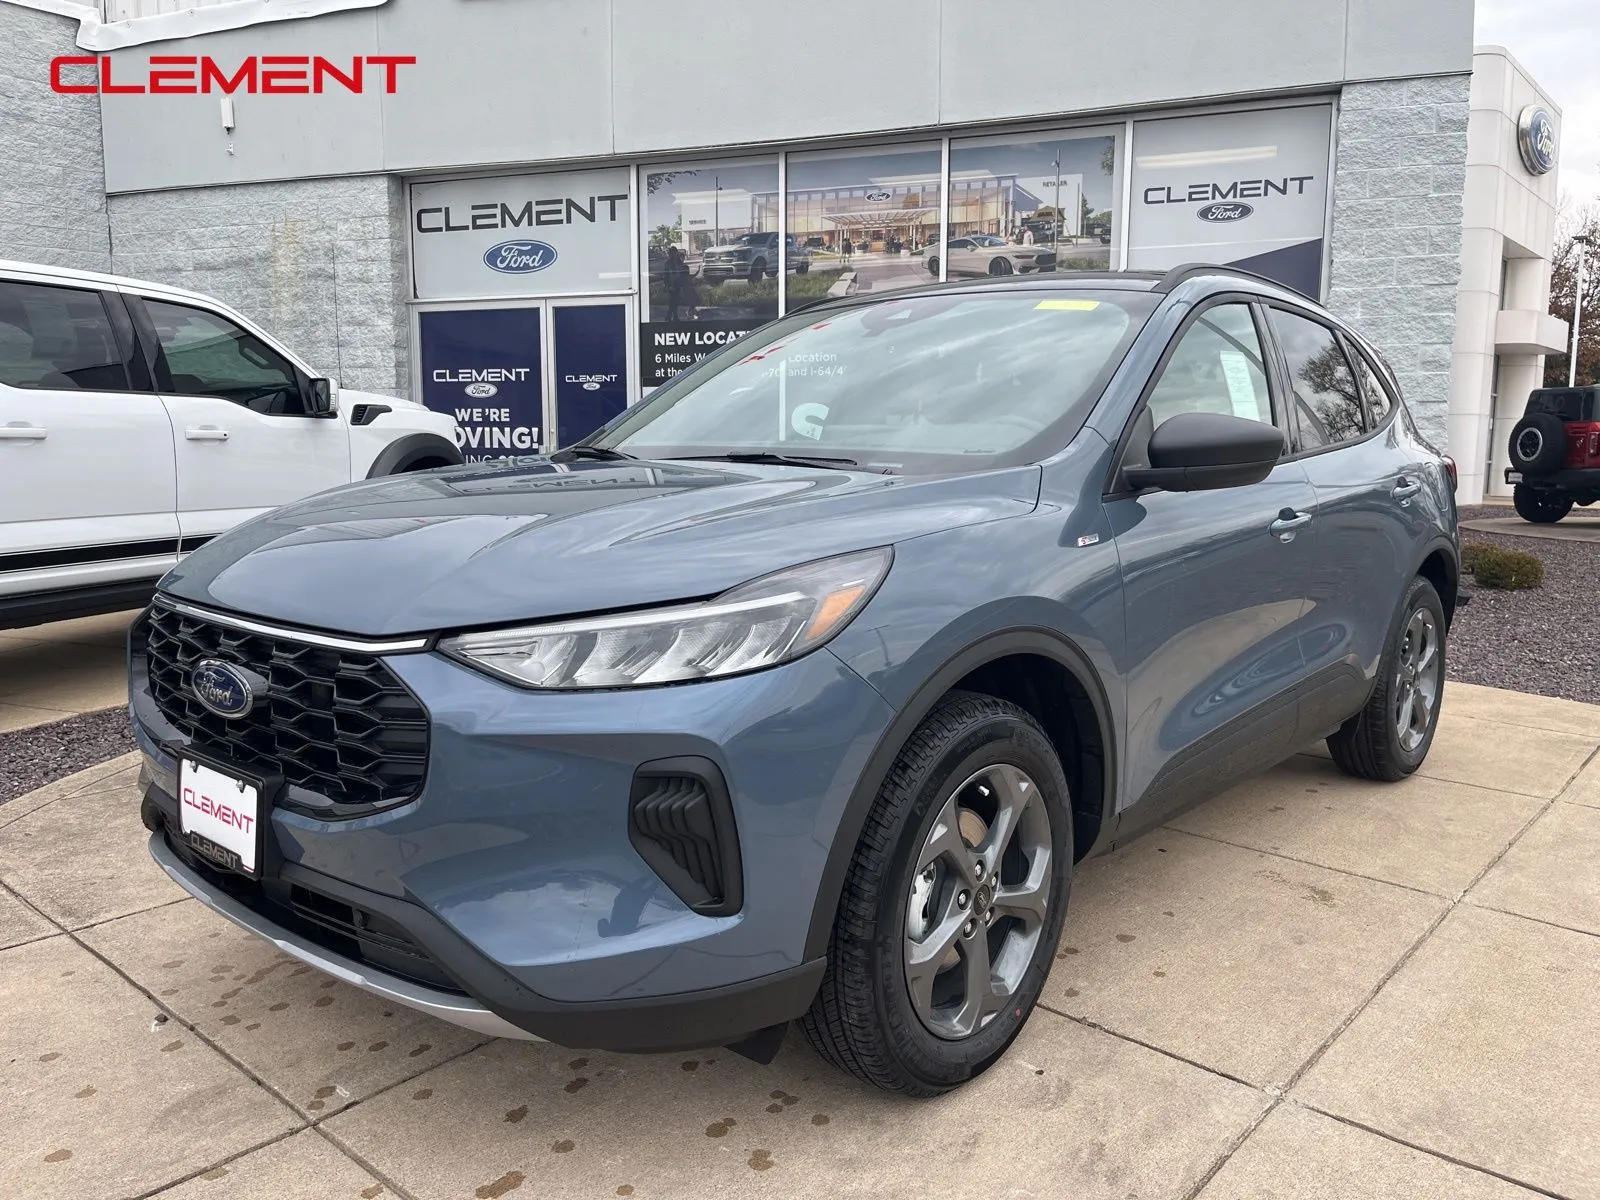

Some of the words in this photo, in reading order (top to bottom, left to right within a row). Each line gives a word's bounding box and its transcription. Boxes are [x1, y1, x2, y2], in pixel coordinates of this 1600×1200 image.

[1042, 180, 1068, 188] RETALER
[1144, 176, 1313, 205] CLEMENT
[416, 194, 628, 233] CLEMENT
[1208, 205, 1242, 220] Ford
[496, 245, 543, 269] Ford
[654, 332, 691, 346] NEW
[694, 330, 751, 345] LOCAT
[655, 354, 662, 363] 6
[664, 353, 691, 363] Miles
[433, 368, 530, 382] CLEMENT
[565, 374, 618, 383] CLEMENT
[655, 368, 665, 377] at
[787, 368, 807, 377] and
[810, 365, 848, 377] I-64/4
[454, 408, 511, 422] WE'RE
[454, 426, 539, 449] OVING!
[201, 671, 233, 706] Ford
[184, 788, 254, 834] CLEMENT
[191, 834, 239, 869] CLEMENT
